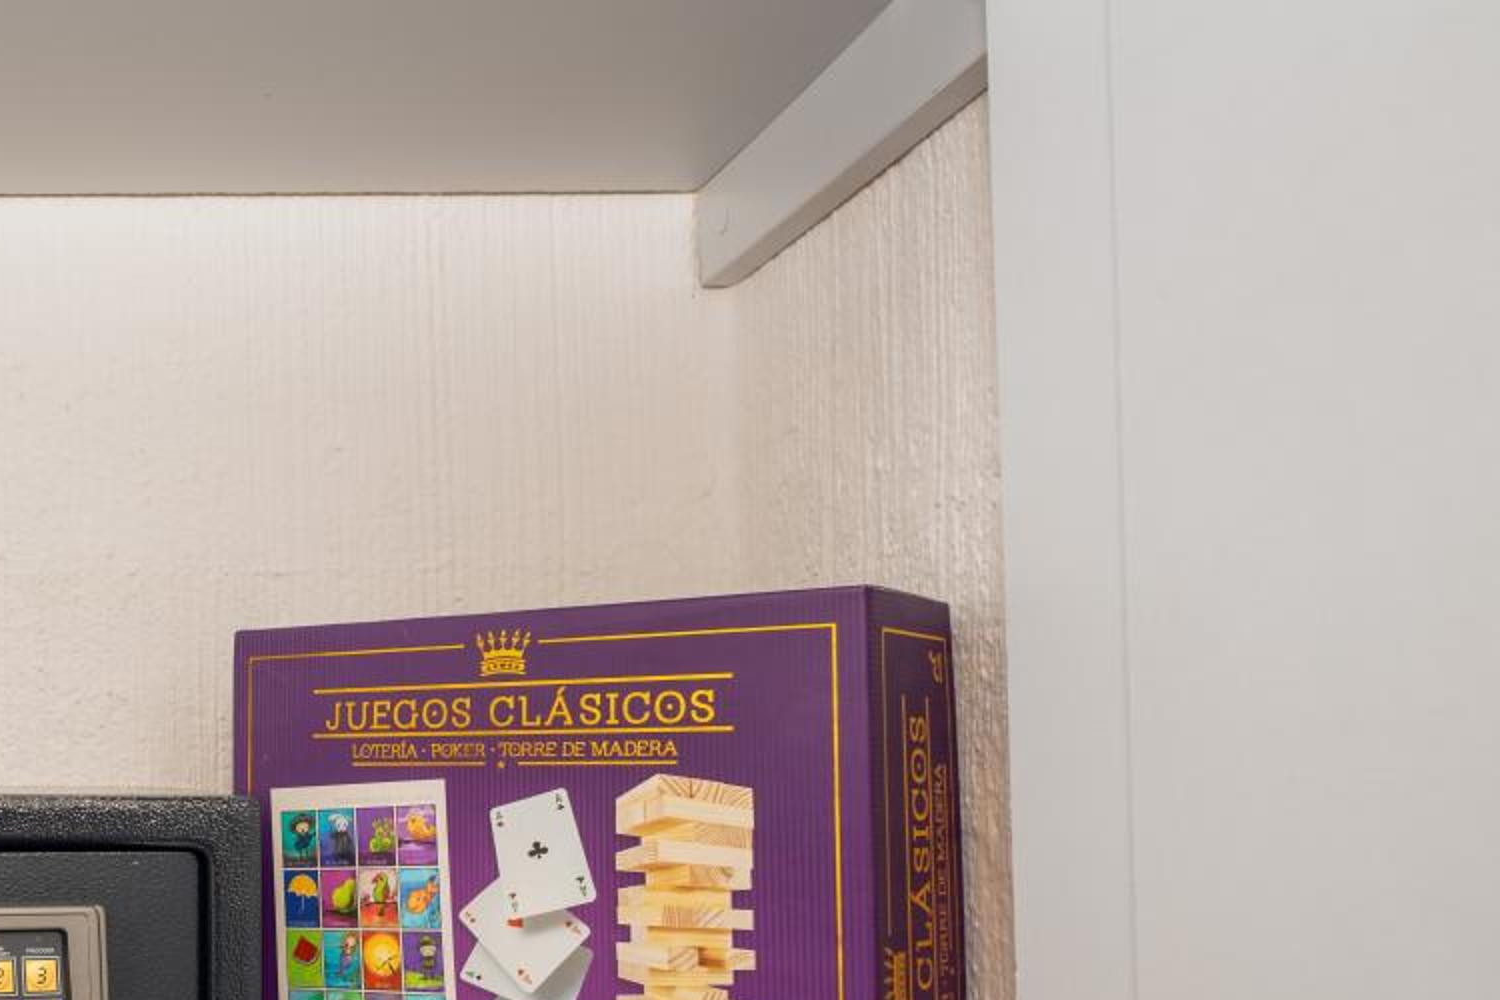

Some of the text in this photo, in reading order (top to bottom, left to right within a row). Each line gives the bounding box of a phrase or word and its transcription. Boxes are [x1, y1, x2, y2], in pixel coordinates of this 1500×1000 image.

[325, 686, 716, 731] JUEGOS CLÁSICOS
[352, 738, 678, 760] LOTERÍA POKER TORRE DE MADERA
[910, 716, 933, 990] CLÁSICOS
[37, 966, 47, 985] 3
